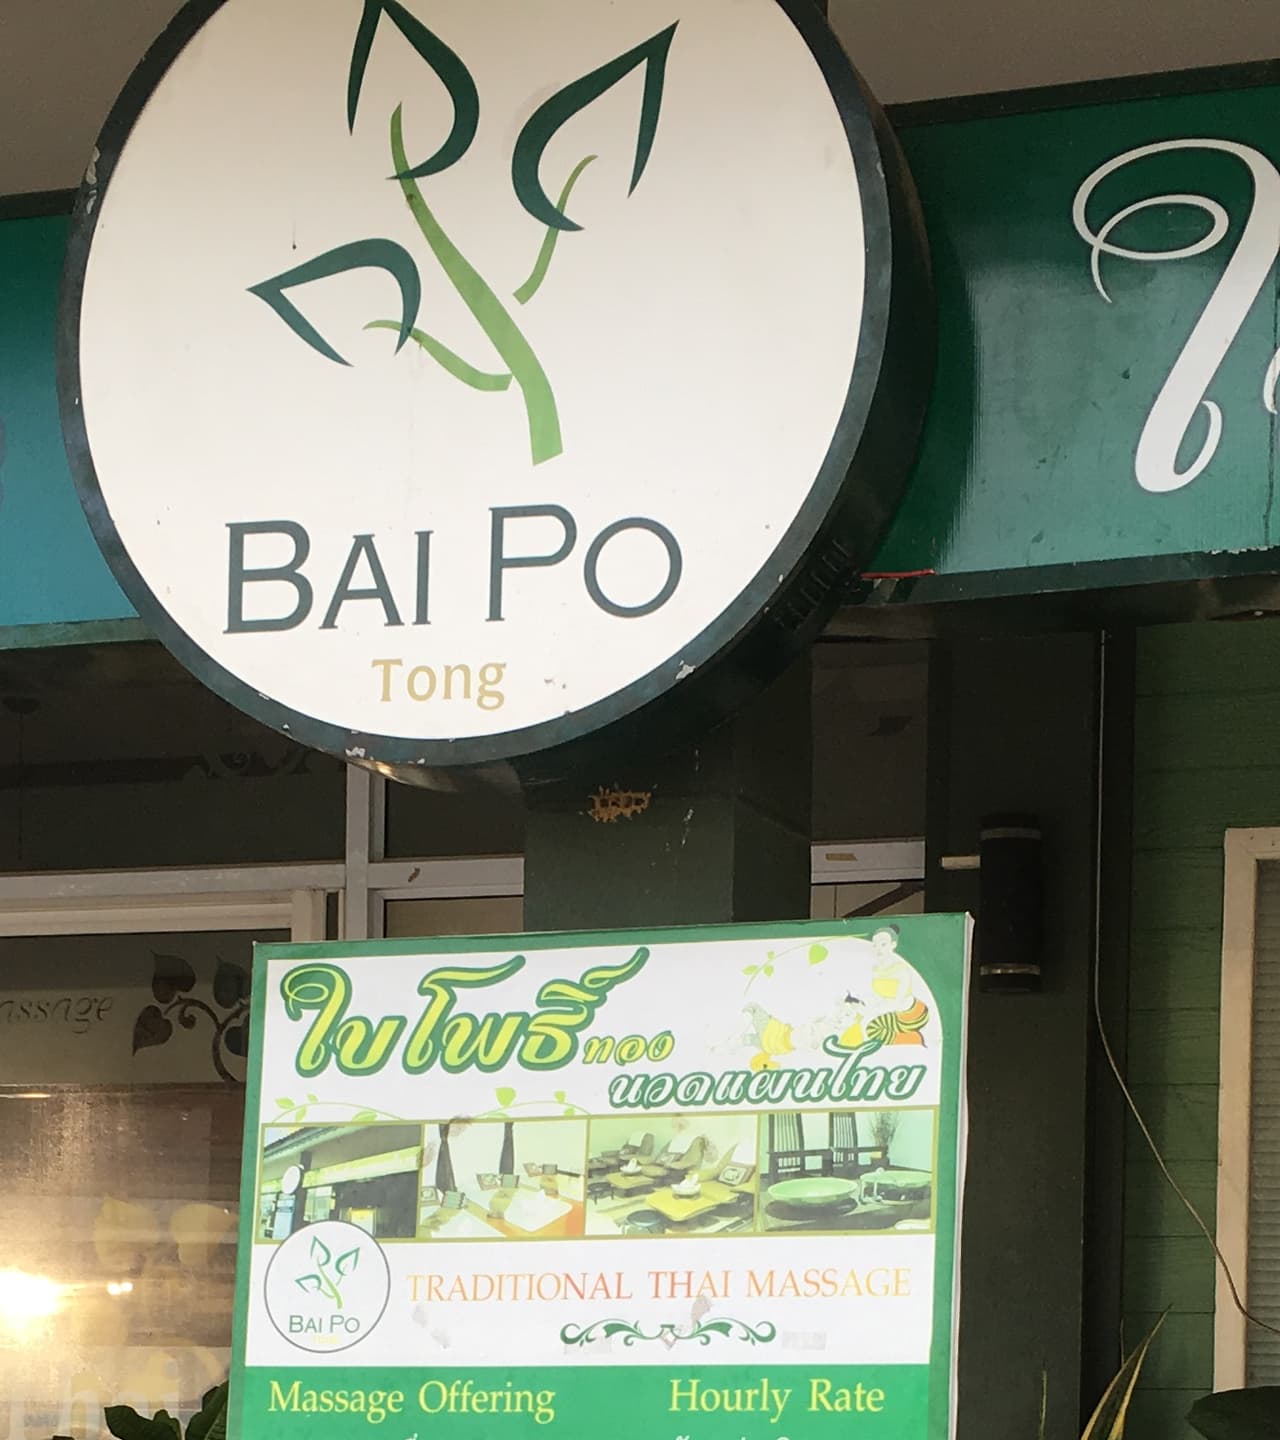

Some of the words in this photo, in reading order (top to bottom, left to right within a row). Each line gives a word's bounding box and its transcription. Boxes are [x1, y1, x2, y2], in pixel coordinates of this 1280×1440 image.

[222, 519, 435, 635] BAI
[371, 658, 508, 711] Tong
[582, 1030, 676, 1066] ทอง
[606, 1030, 927, 1109] นวดแผนไทย
[406, 1272, 633, 1303] TRADITIONAL
[647, 1269, 734, 1300] THAI
[746, 1267, 912, 1299] MASSAGE
[288, 1314, 322, 1334] BAI
[268, 1380, 405, 1424] Massage
[418, 1379, 557, 1424] Offering
[668, 1378, 793, 1424] Hourly
[807, 1378, 886, 1413] Rate
